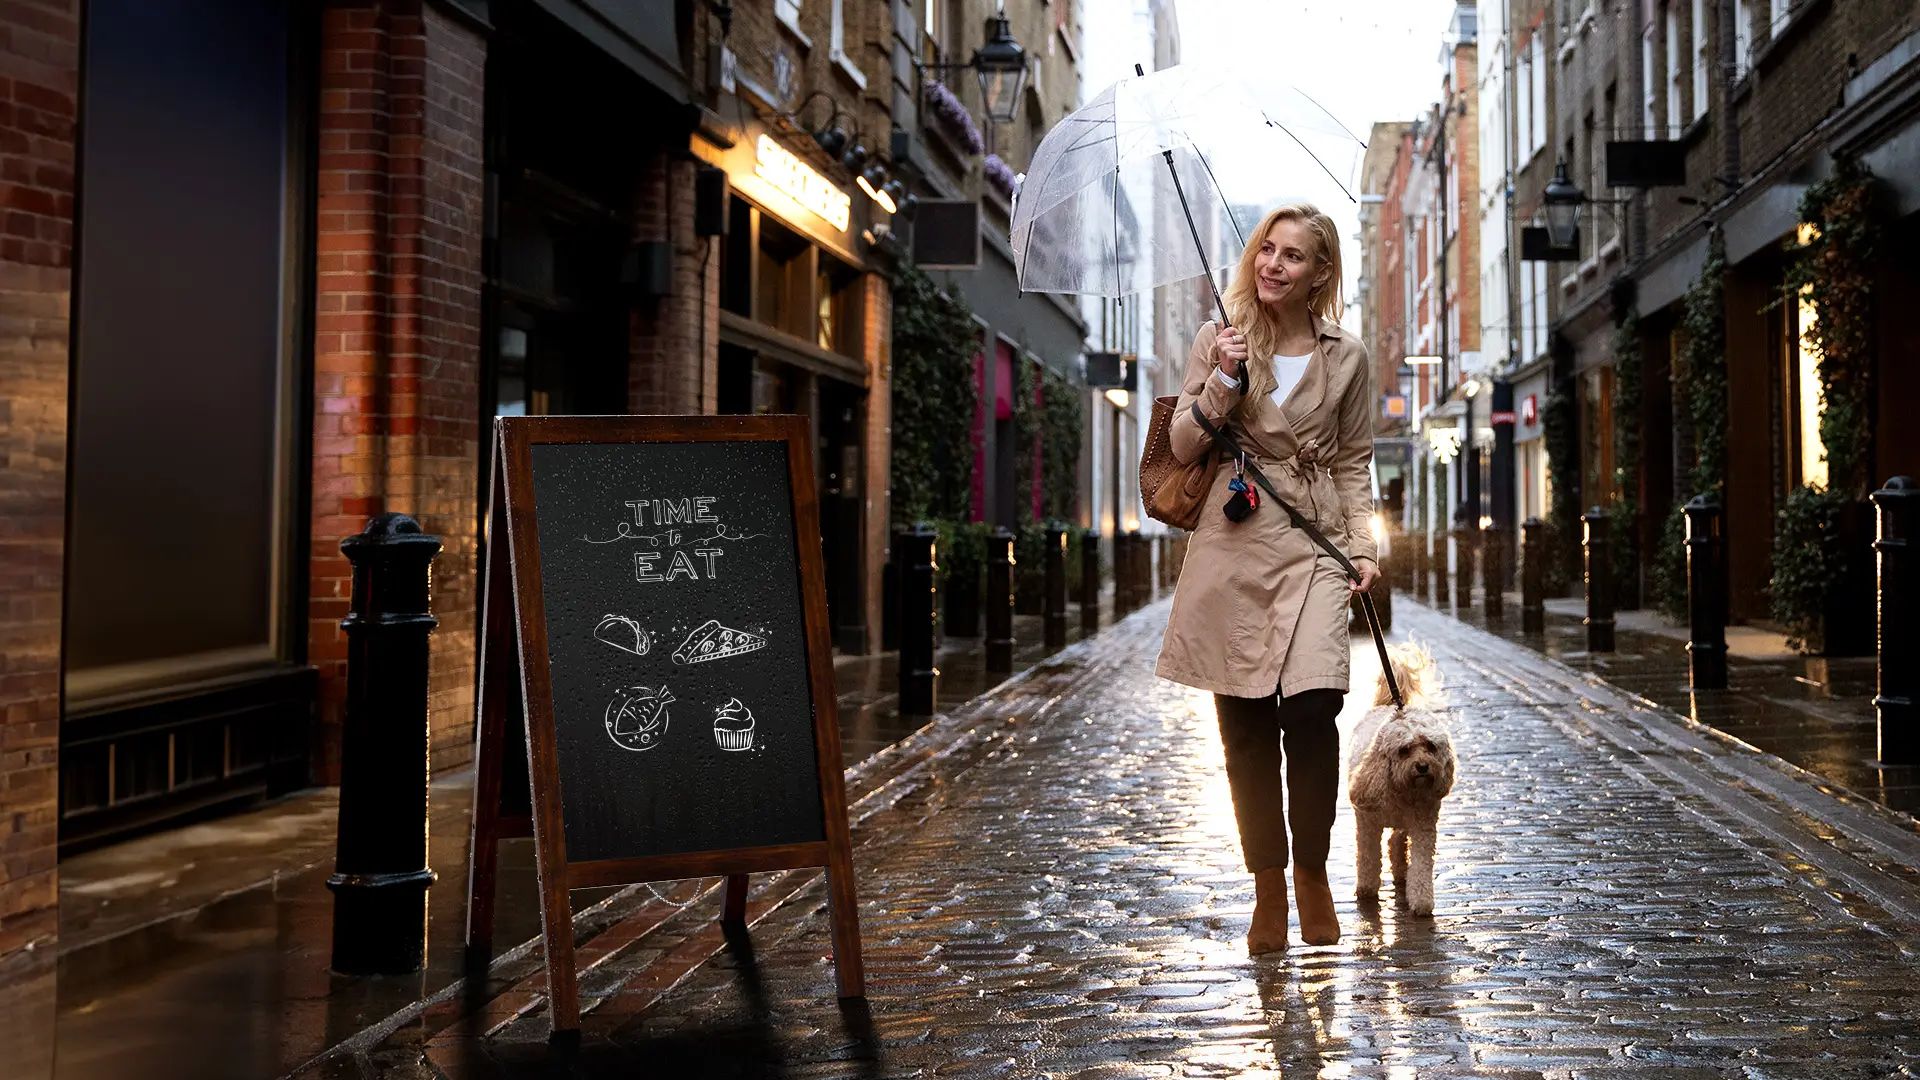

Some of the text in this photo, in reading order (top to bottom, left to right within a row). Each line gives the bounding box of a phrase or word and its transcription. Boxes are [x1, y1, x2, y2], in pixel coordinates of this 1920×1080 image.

[625, 496, 719, 526] TIME
[667, 529, 681, 546] to
[634, 548, 723, 582] EAT
